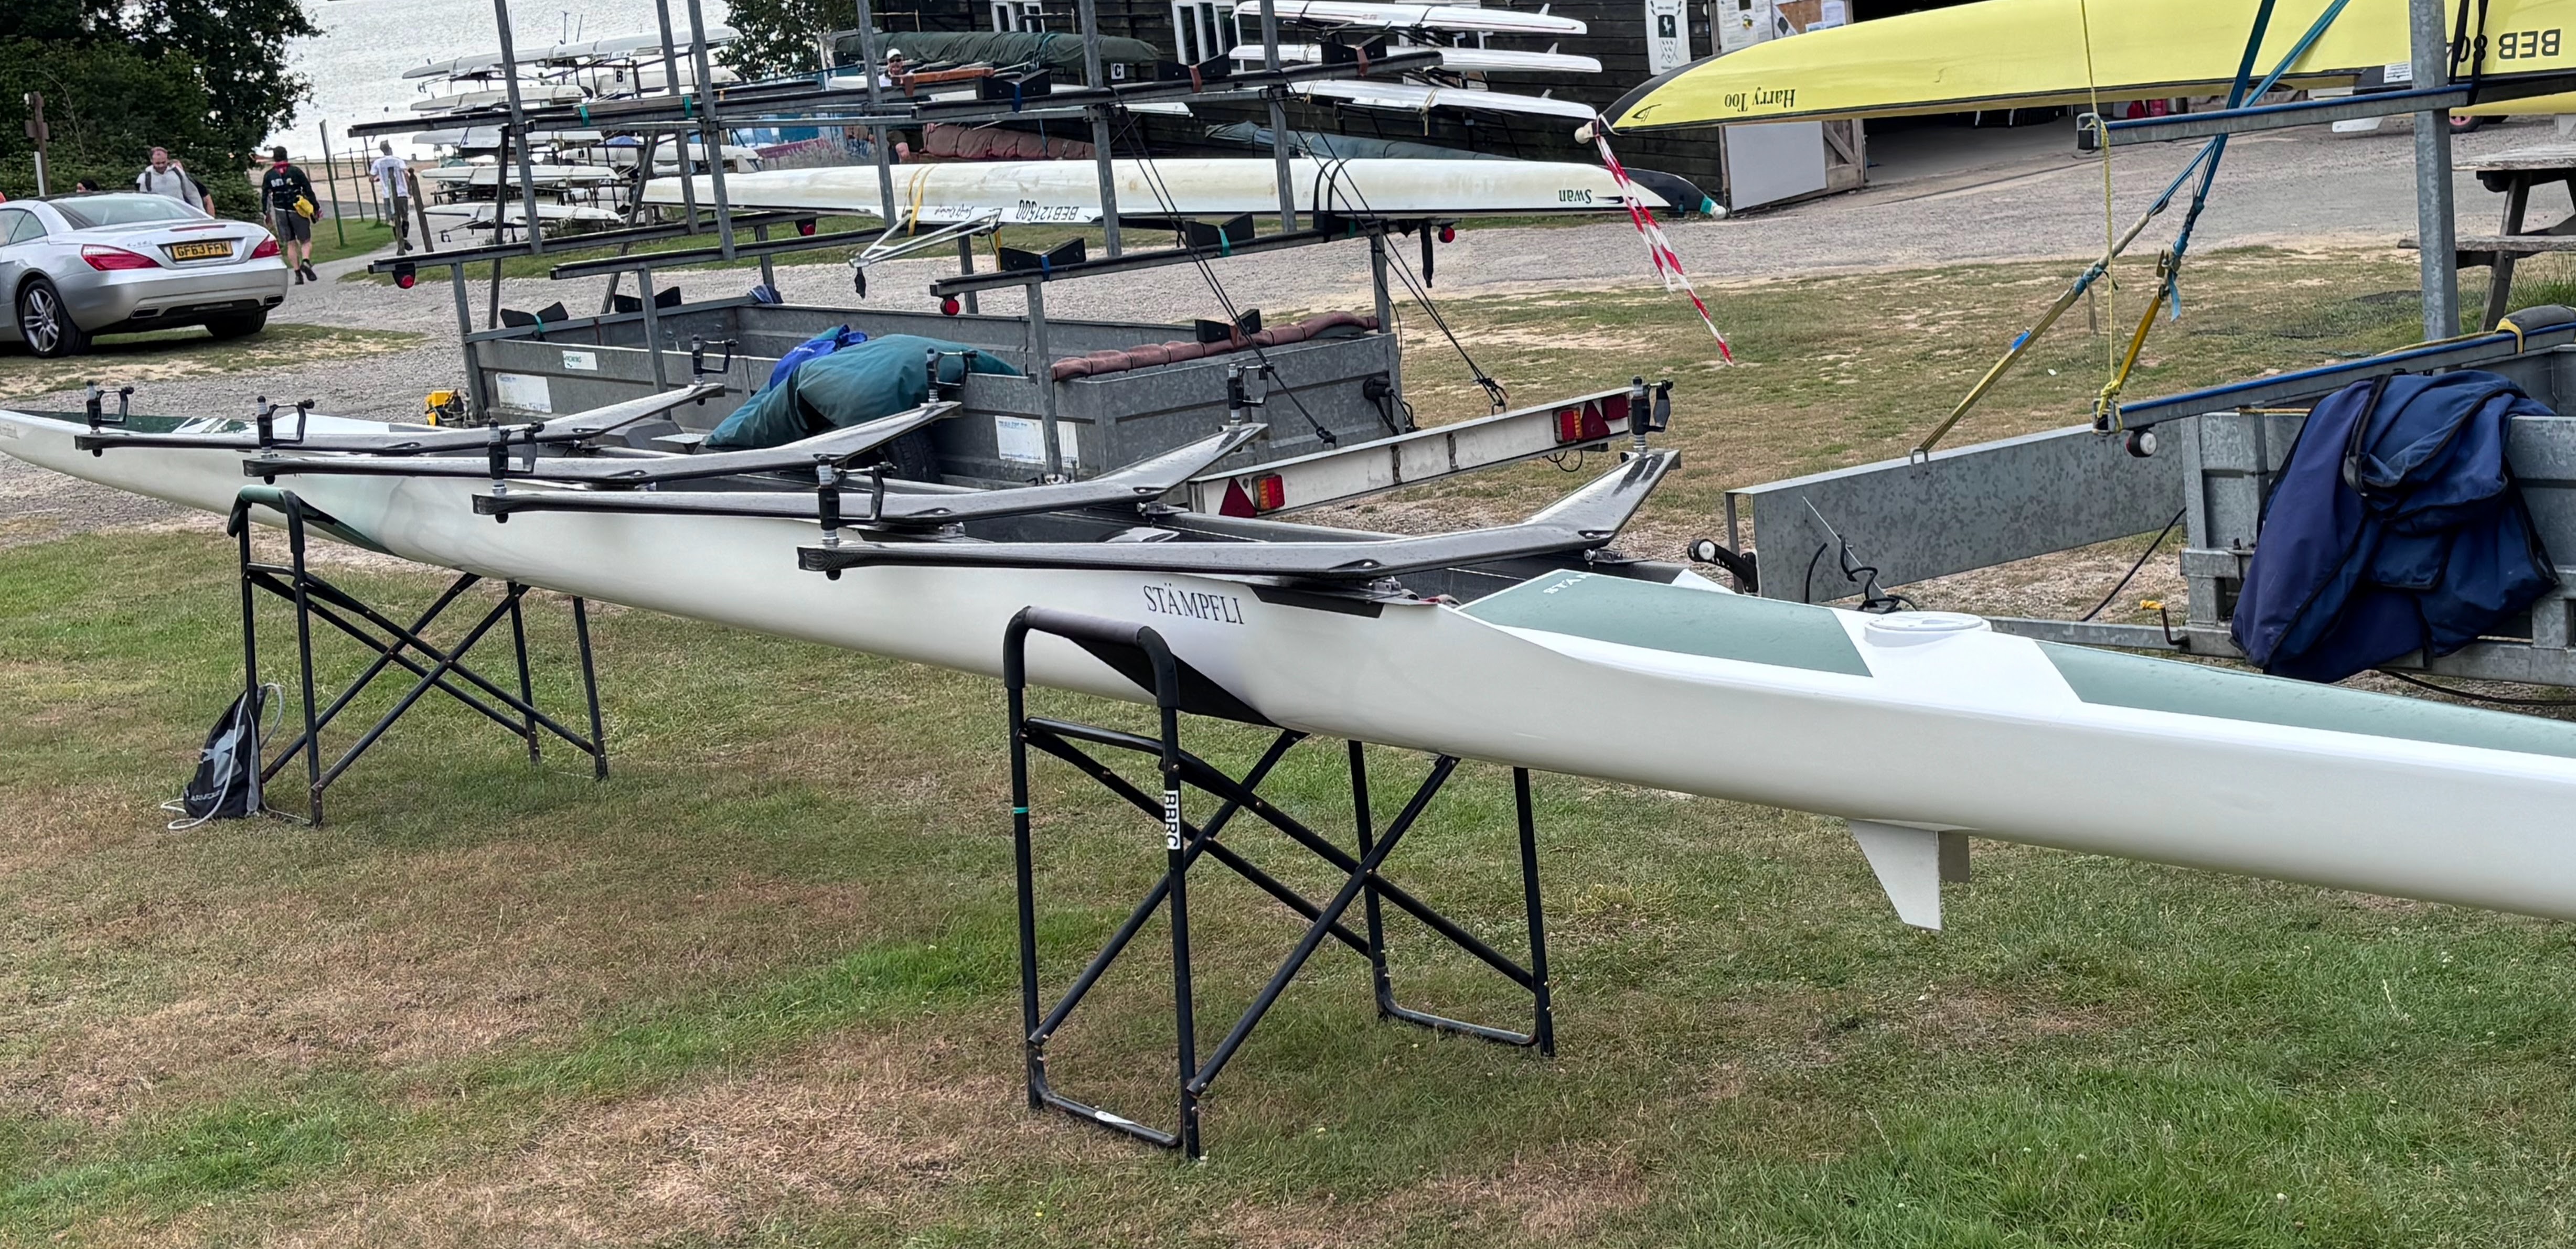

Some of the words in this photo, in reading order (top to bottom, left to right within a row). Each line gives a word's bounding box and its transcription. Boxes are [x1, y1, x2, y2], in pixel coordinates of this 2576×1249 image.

[2498, 28, 2561, 60] BEB
[616, 70, 624, 82] B
[1115, 64, 1121, 77] C
[1724, 93, 1748, 112] Too
[1752, 86, 1796, 109] Harry
[1558, 189, 1592, 204] Swan
[1016, 199, 1079, 221] BEB121500
[176, 243, 205, 257] GF63
[208, 241, 228, 254] FFN
[1143, 582, 1245, 624] STÄMPFLI
[1164, 793, 1178, 847] BBRC
